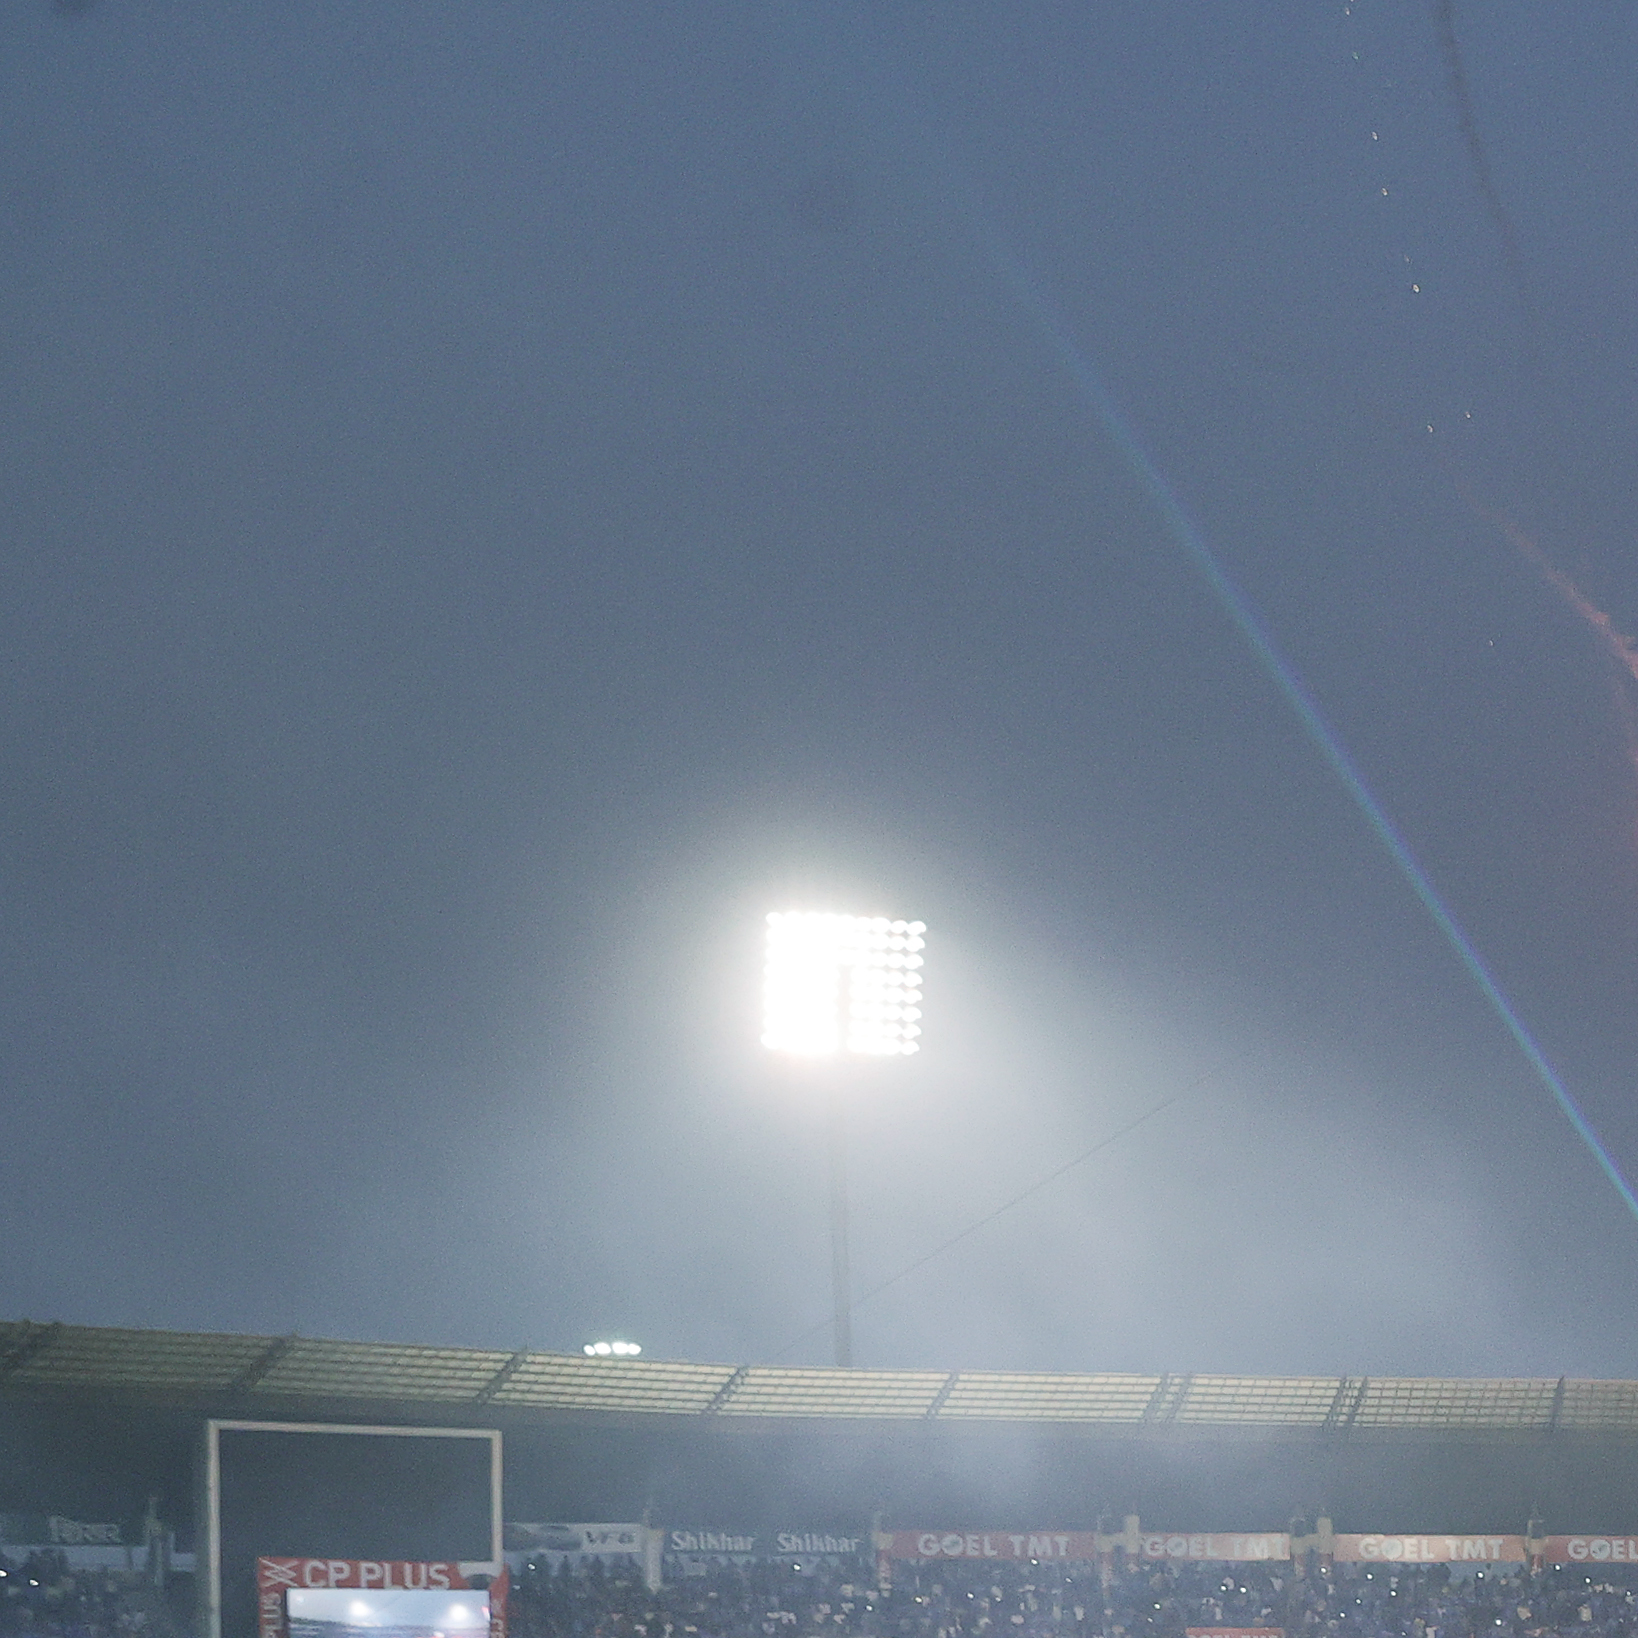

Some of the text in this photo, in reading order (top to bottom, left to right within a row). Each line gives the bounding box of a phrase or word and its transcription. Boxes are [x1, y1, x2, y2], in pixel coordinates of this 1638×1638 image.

[671, 1531, 757, 1551] Shikhar
[776, 1532, 862, 1552] Shikhar
[918, 1533, 1070, 1557] GOEL TMT
[1143, 1535, 1285, 1557] GOEL TMT
[1360, 1537, 1504, 1560] GOEL TMT
[302, 1560, 450, 1590] CP PLUS
